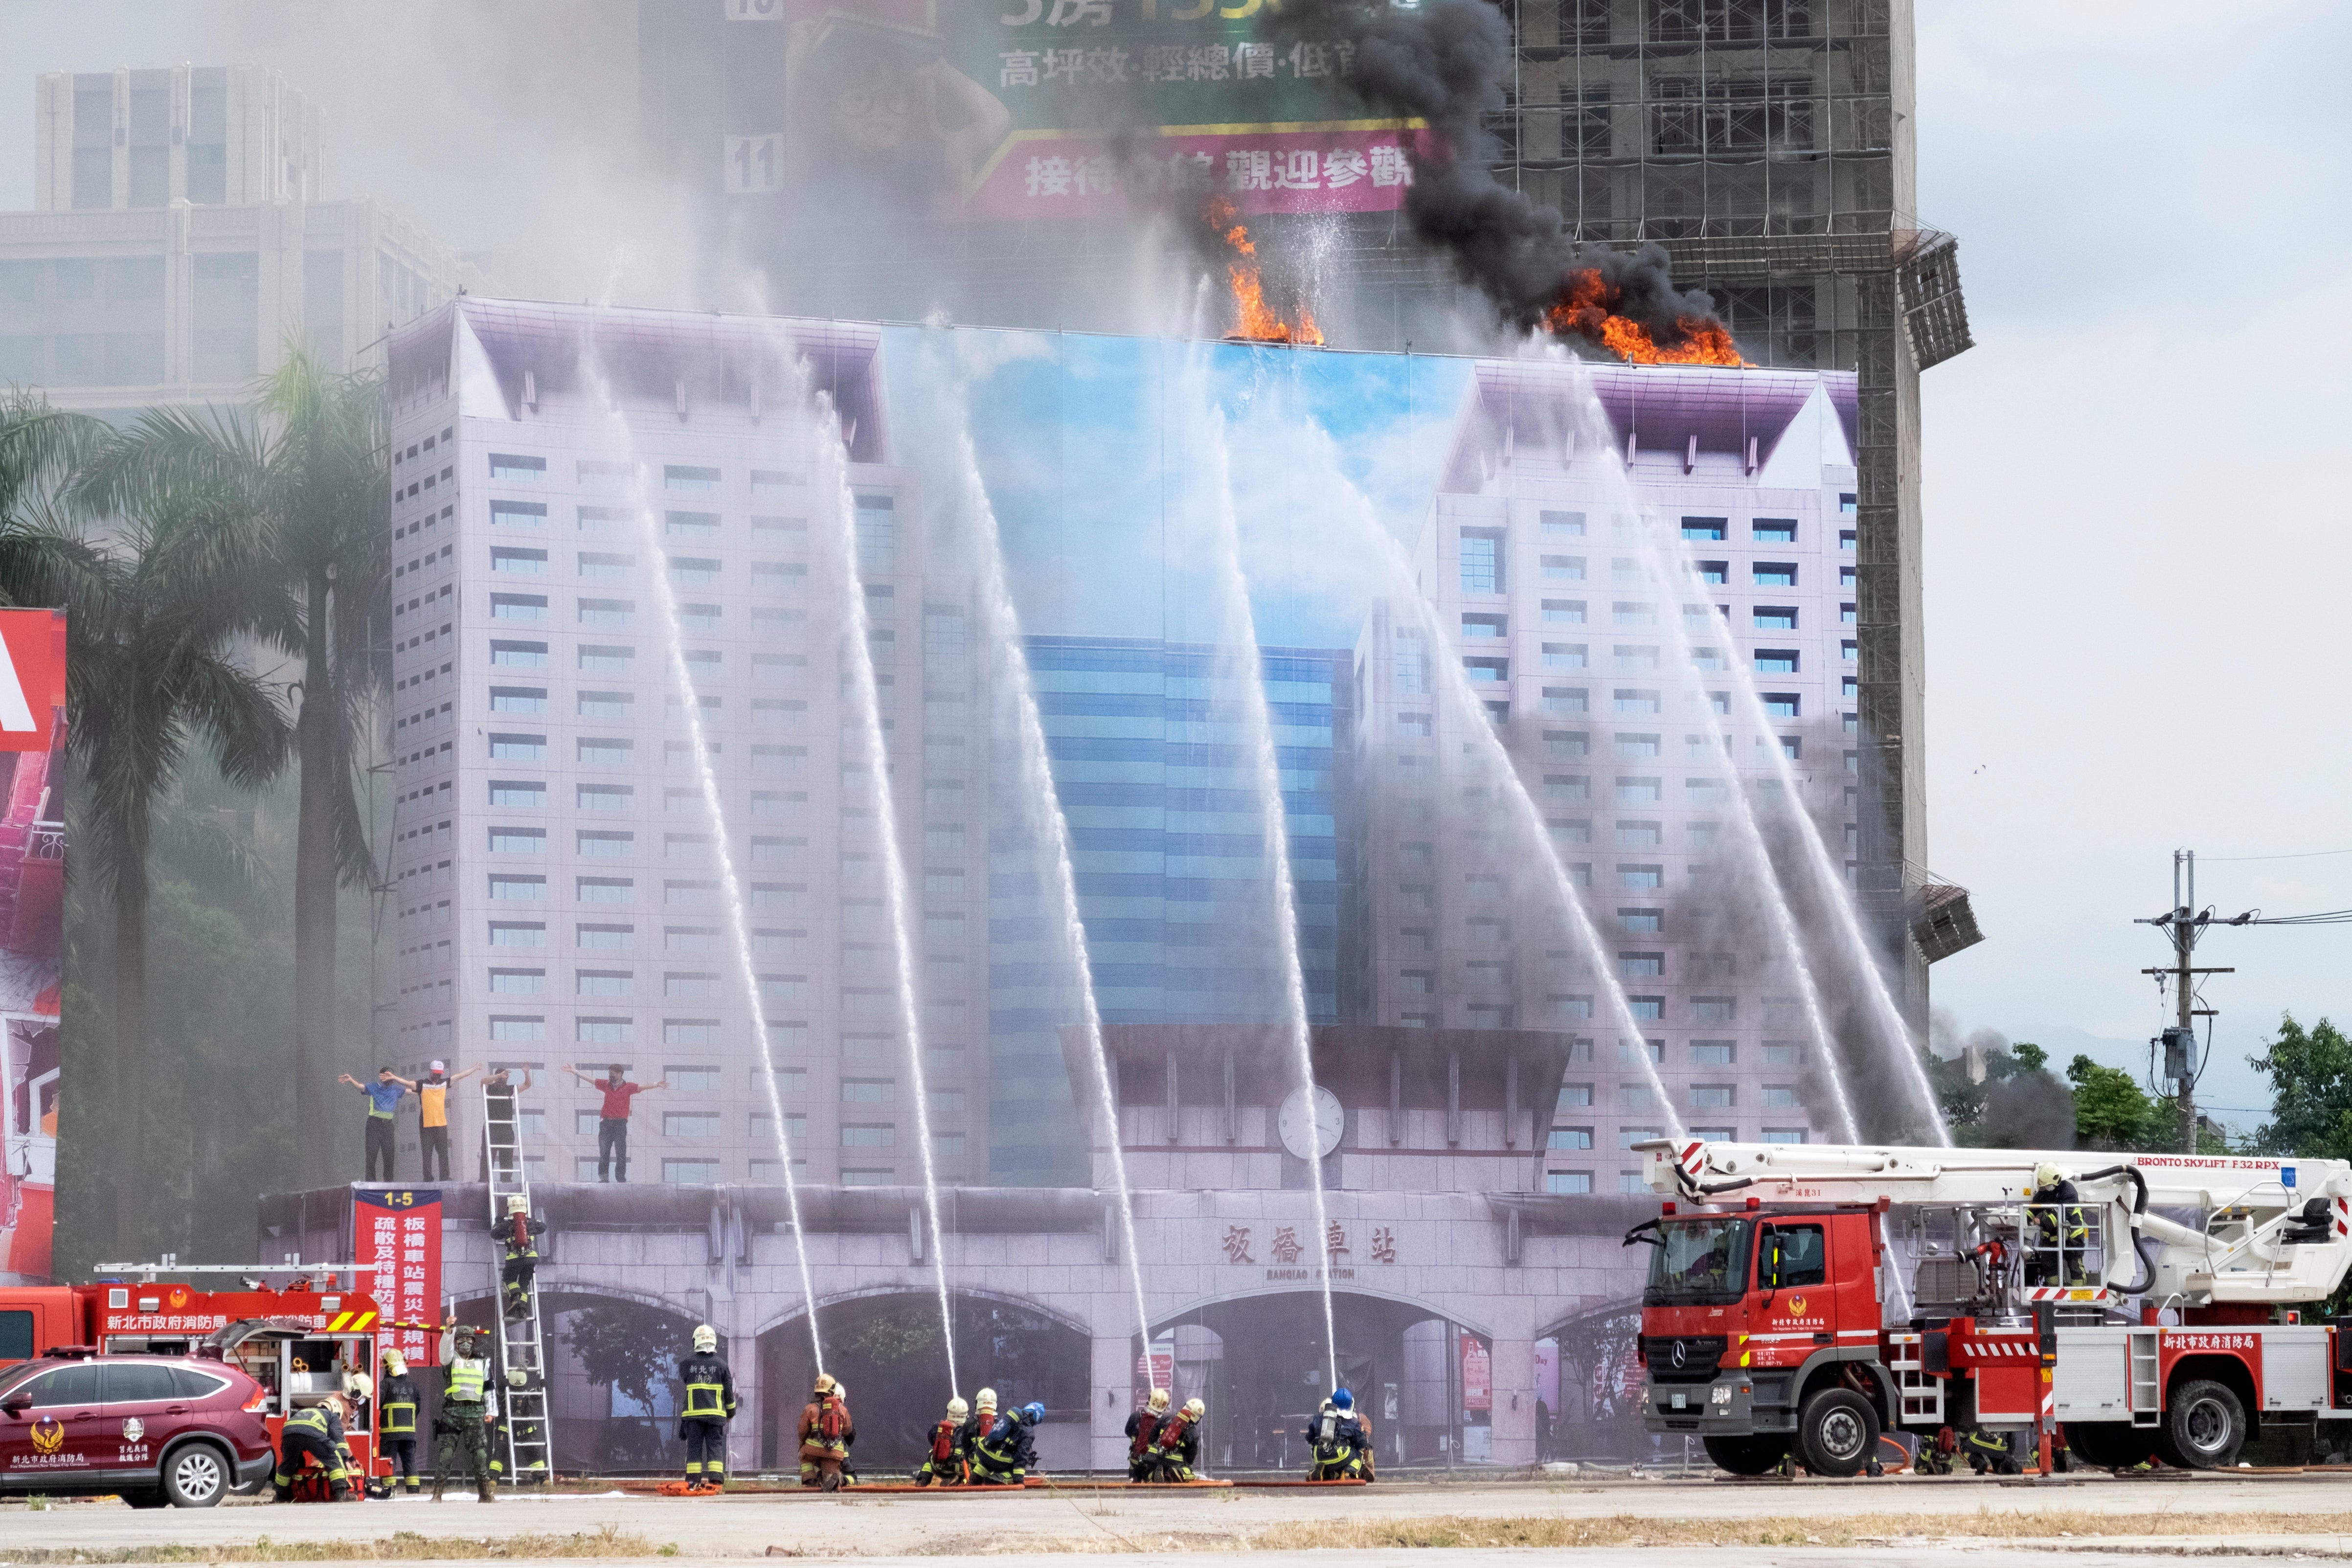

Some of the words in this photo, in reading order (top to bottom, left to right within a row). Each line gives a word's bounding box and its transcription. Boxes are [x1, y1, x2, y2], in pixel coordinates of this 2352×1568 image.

[734, 138, 774, 187] 11
[2137, 1157, 2181, 1167] BRONTO
[2184, 1159, 2227, 1168] SKYLIFT
[2232, 1160, 2238, 1169] F
[2240, 1161, 2253, 1169] 32
[2255, 1161, 2280, 1170] RPX
[384, 1192, 413, 1206] 1-5
[1223, 1220, 1396, 1266] 板橋車站
[1266, 1270, 1308, 1280] BANQIAO
[1316, 1269, 1355, 1280] SATION
[403, 1217, 425, 1360] 板橋車站震災大規模
[107, 1315, 227, 1330] 新北市政府消防局
[2164, 1335, 2254, 1350] 新北市政府消防局
[689, 1365, 717, 1374] 新北市
[695, 1374, 712, 1384] 消防
[12, 1453, 84, 1464] 新北市政府消防局
